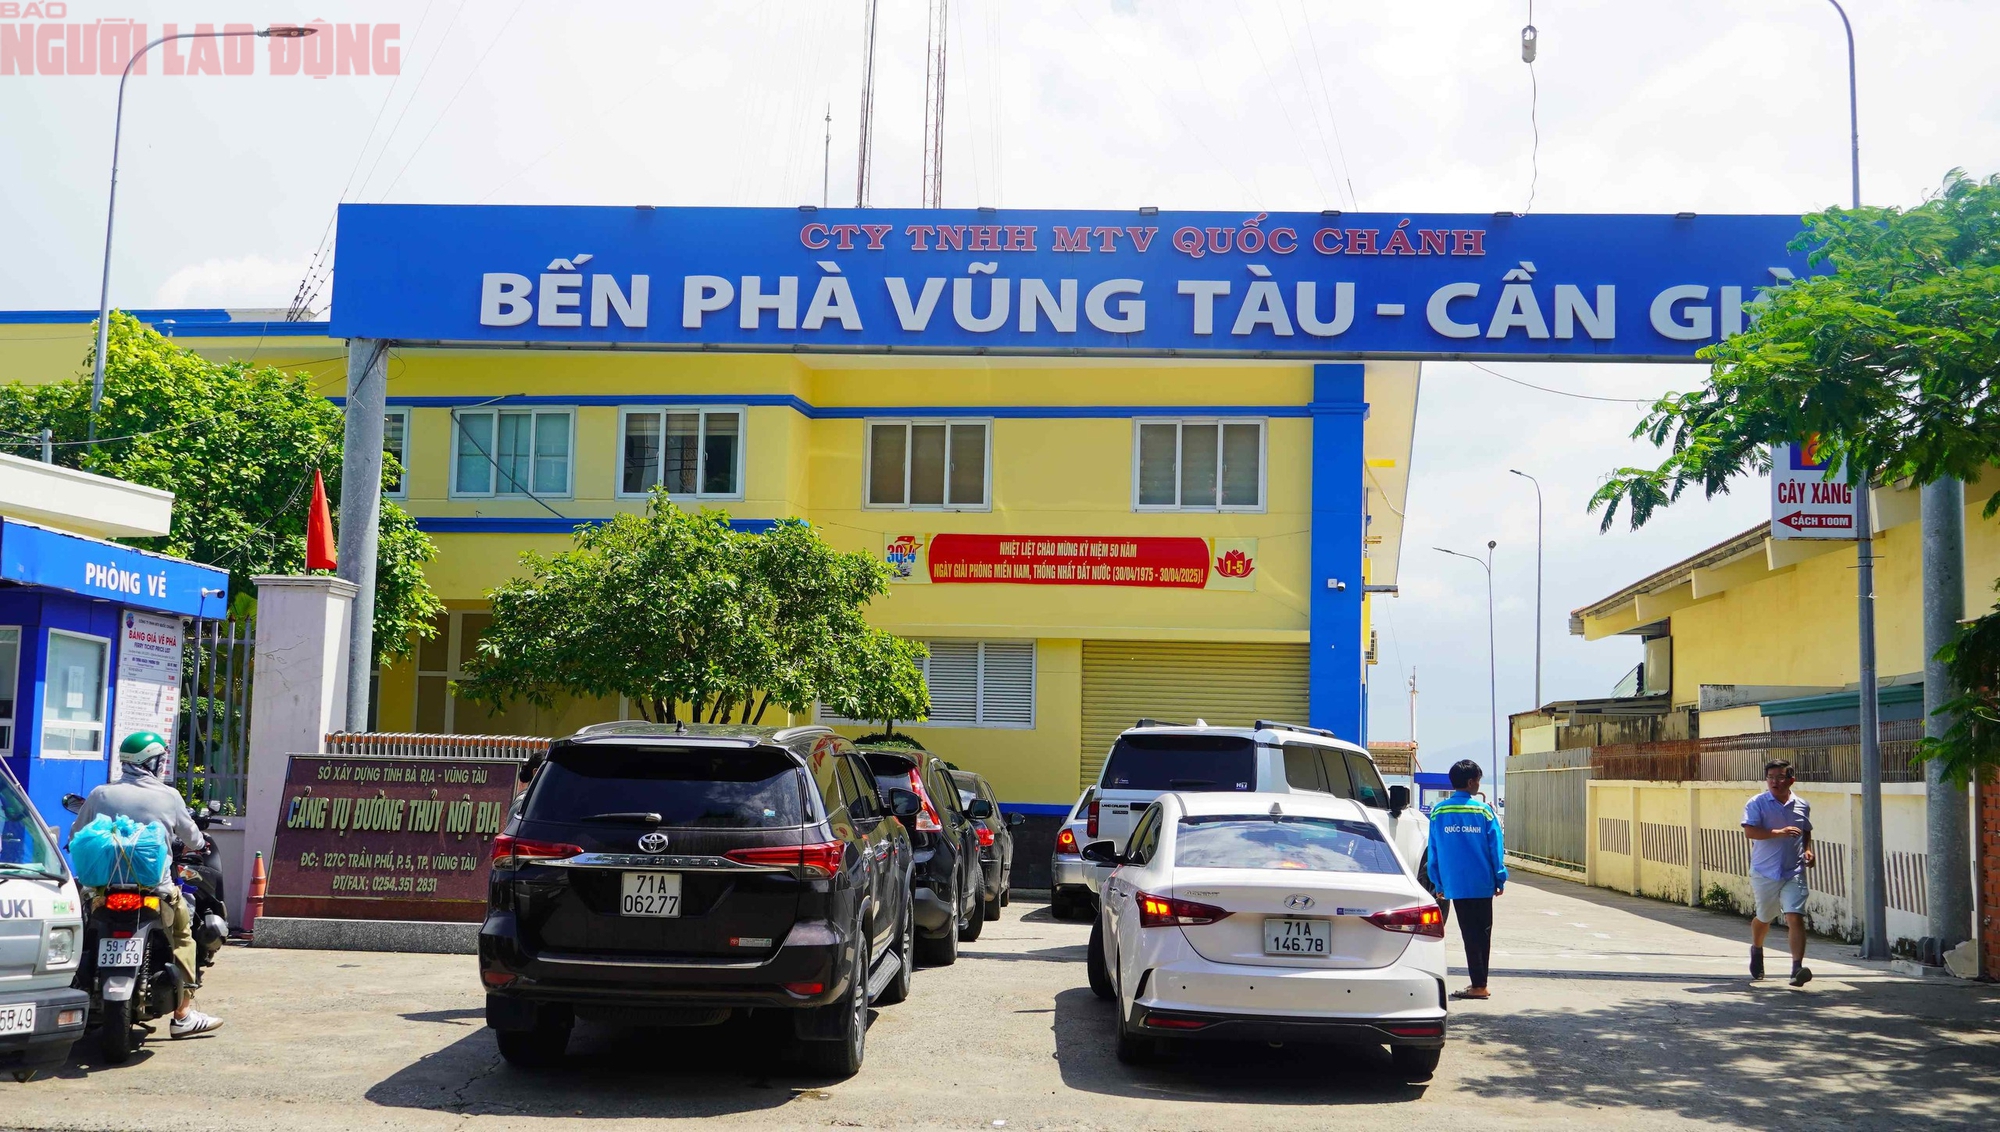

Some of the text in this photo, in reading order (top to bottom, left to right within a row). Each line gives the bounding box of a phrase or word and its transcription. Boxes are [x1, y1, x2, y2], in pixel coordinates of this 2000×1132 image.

[800, 212, 1487, 258] CTY TNHH MTV QUỐC CHÁNH
[479, 253, 650, 328] BẾN
[682, 261, 863, 331] PHÀ
[884, 262, 1146, 334] VŨNG
[1177, 264, 1356, 337] TÀU
[1376, 303, 1405, 317] -
[1427, 261, 1617, 341] CẦN
[1778, 478, 1852, 504] CÂY XĂNG
[1791, 515, 1849, 526] CÁCH 100M
[1000, 539, 1137, 560] NHIỆT LIỆT CHÀO MỪNG KỶ NIỆM 50 NĂM
[934, 561, 952, 578] NGÀY
[953, 559, 967, 578] GIẢI
[969, 562, 993, 578] PHÓNG
[994, 560, 1012, 579] MIỀN
[1013, 564, 1032, 580] NAM,
[1033, 560, 1056, 579] THỐNG
[1057, 560, 1075, 580] NHẤT
[1077, 560, 1090, 580] ĐẤT
[1092, 563, 1111, 580] NƯỚC
[1112, 566, 1153, 582] (30/04/1975
[1226, 560, 1244, 574] 1-5
[85, 562, 167, 598] PHÒNG VÉ
[128, 628, 177, 647] BẢNG GIÁ VÉ PHÀ
[317, 761, 332, 780] SỞ
[333, 763, 351, 780] XÂY
[354, 766, 381, 785] DỰNG
[383, 762, 403, 782] TỈNH
[405, 765, 417, 782] BÀ
[420, 768, 435, 786] RỊA
[444, 766, 469, 783] VŨNG
[472, 766, 488, 784] TÀU
[287, 785, 329, 829] CẢNG
[331, 797, 352, 837] VỤ
[407, 789, 445, 833] THỦY
[446, 794, 474, 840] NỘI
[475, 800, 501, 840] ĐỊA
[1444, 824, 1481, 834] QUỐC CHÁNH
[300, 852, 319, 867] ĐC:
[323, 852, 346, 867] 127C
[348, 846, 373, 868] TRẦN
[374, 850, 395, 872] PHÚ,
[417, 855, 429, 870] TP.
[432, 853, 458, 870] VŨNG
[460, 852, 477, 871] TÀU
[332, 875, 438, 892] ĐT/FAX: 0254.351 2831
[636, 874, 667, 894] 71A
[0, 899, 34, 919] UKI
[623, 894, 679, 915] 062.77
[1283, 921, 1312, 936] 71A
[1273, 937, 1324, 952] 146.78
[101, 953, 140, 965] 330.59
[0, 1007, 33, 1031] 55.49
